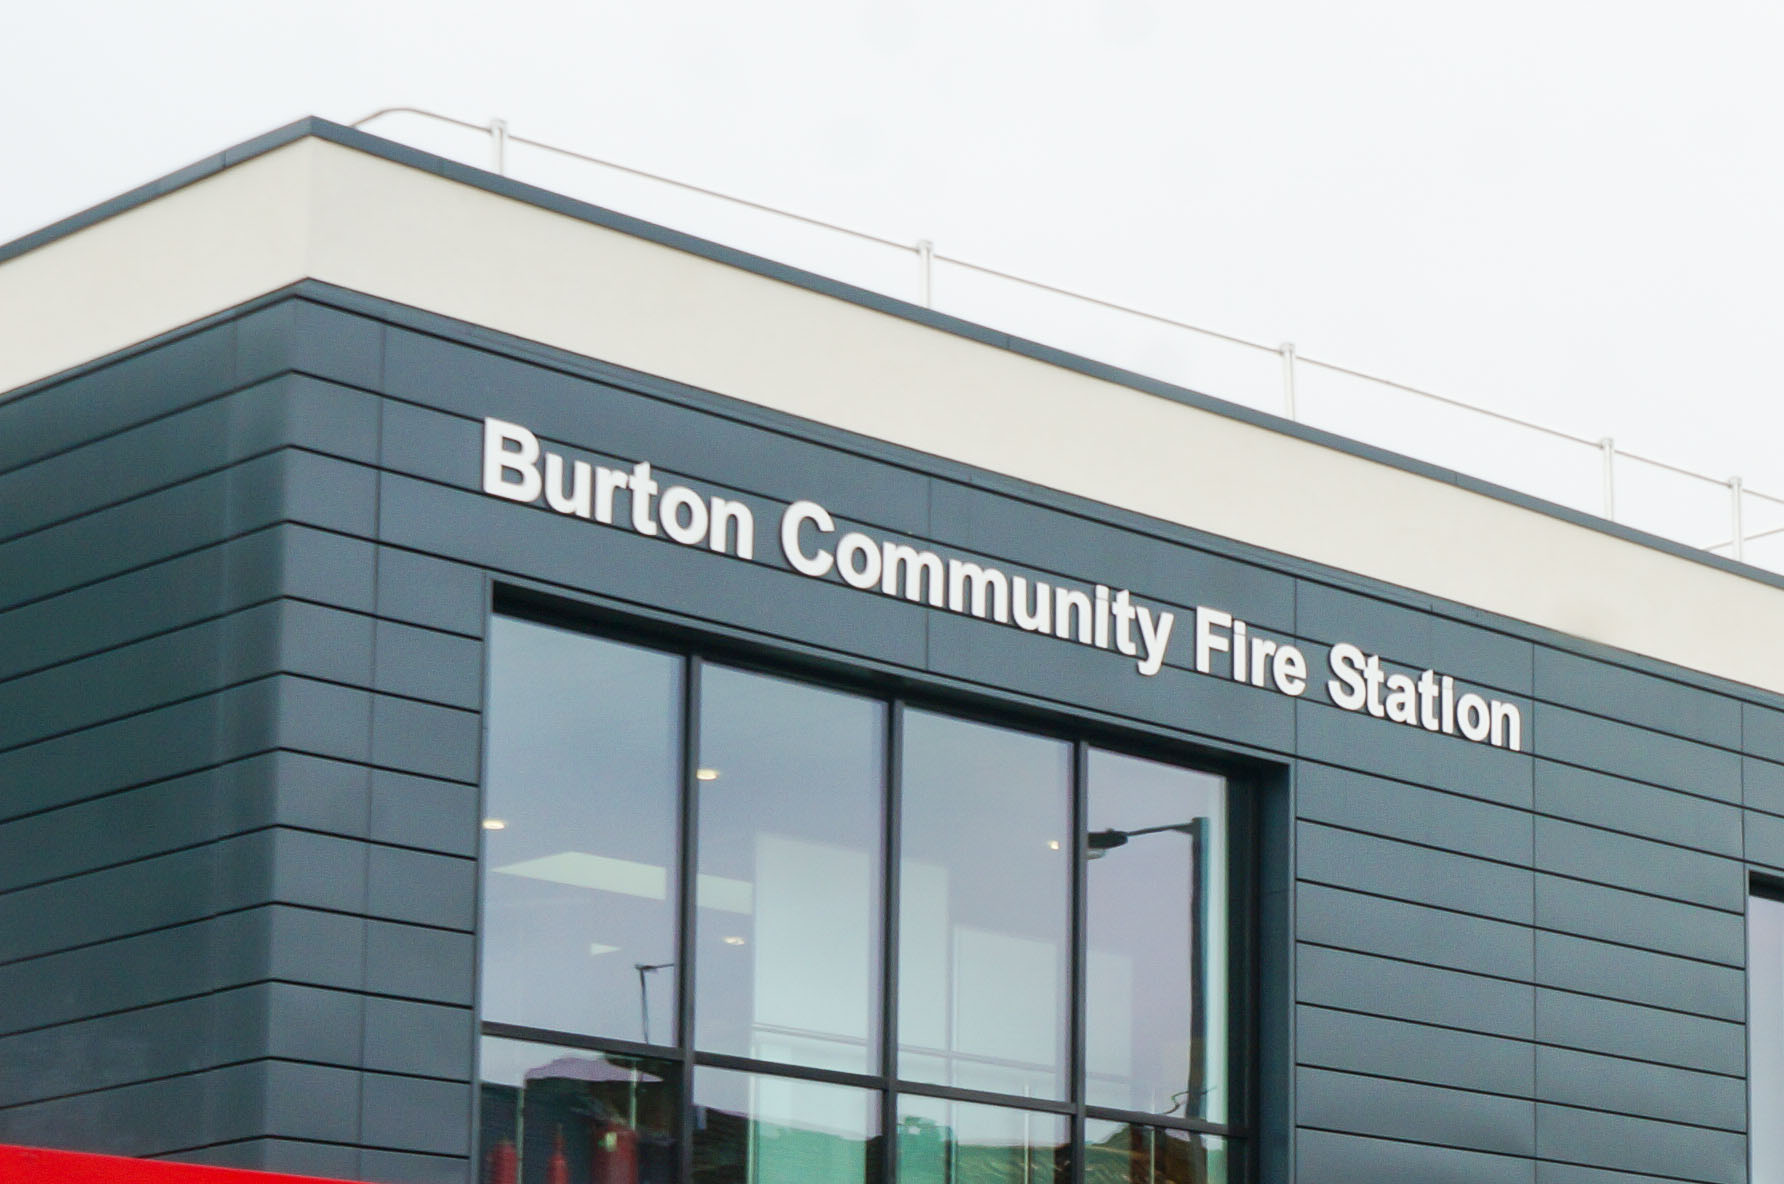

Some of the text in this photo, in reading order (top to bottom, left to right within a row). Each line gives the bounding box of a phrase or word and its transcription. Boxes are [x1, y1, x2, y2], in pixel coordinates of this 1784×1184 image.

[483, 416, 1521, 752] Burton Community Fire Station
